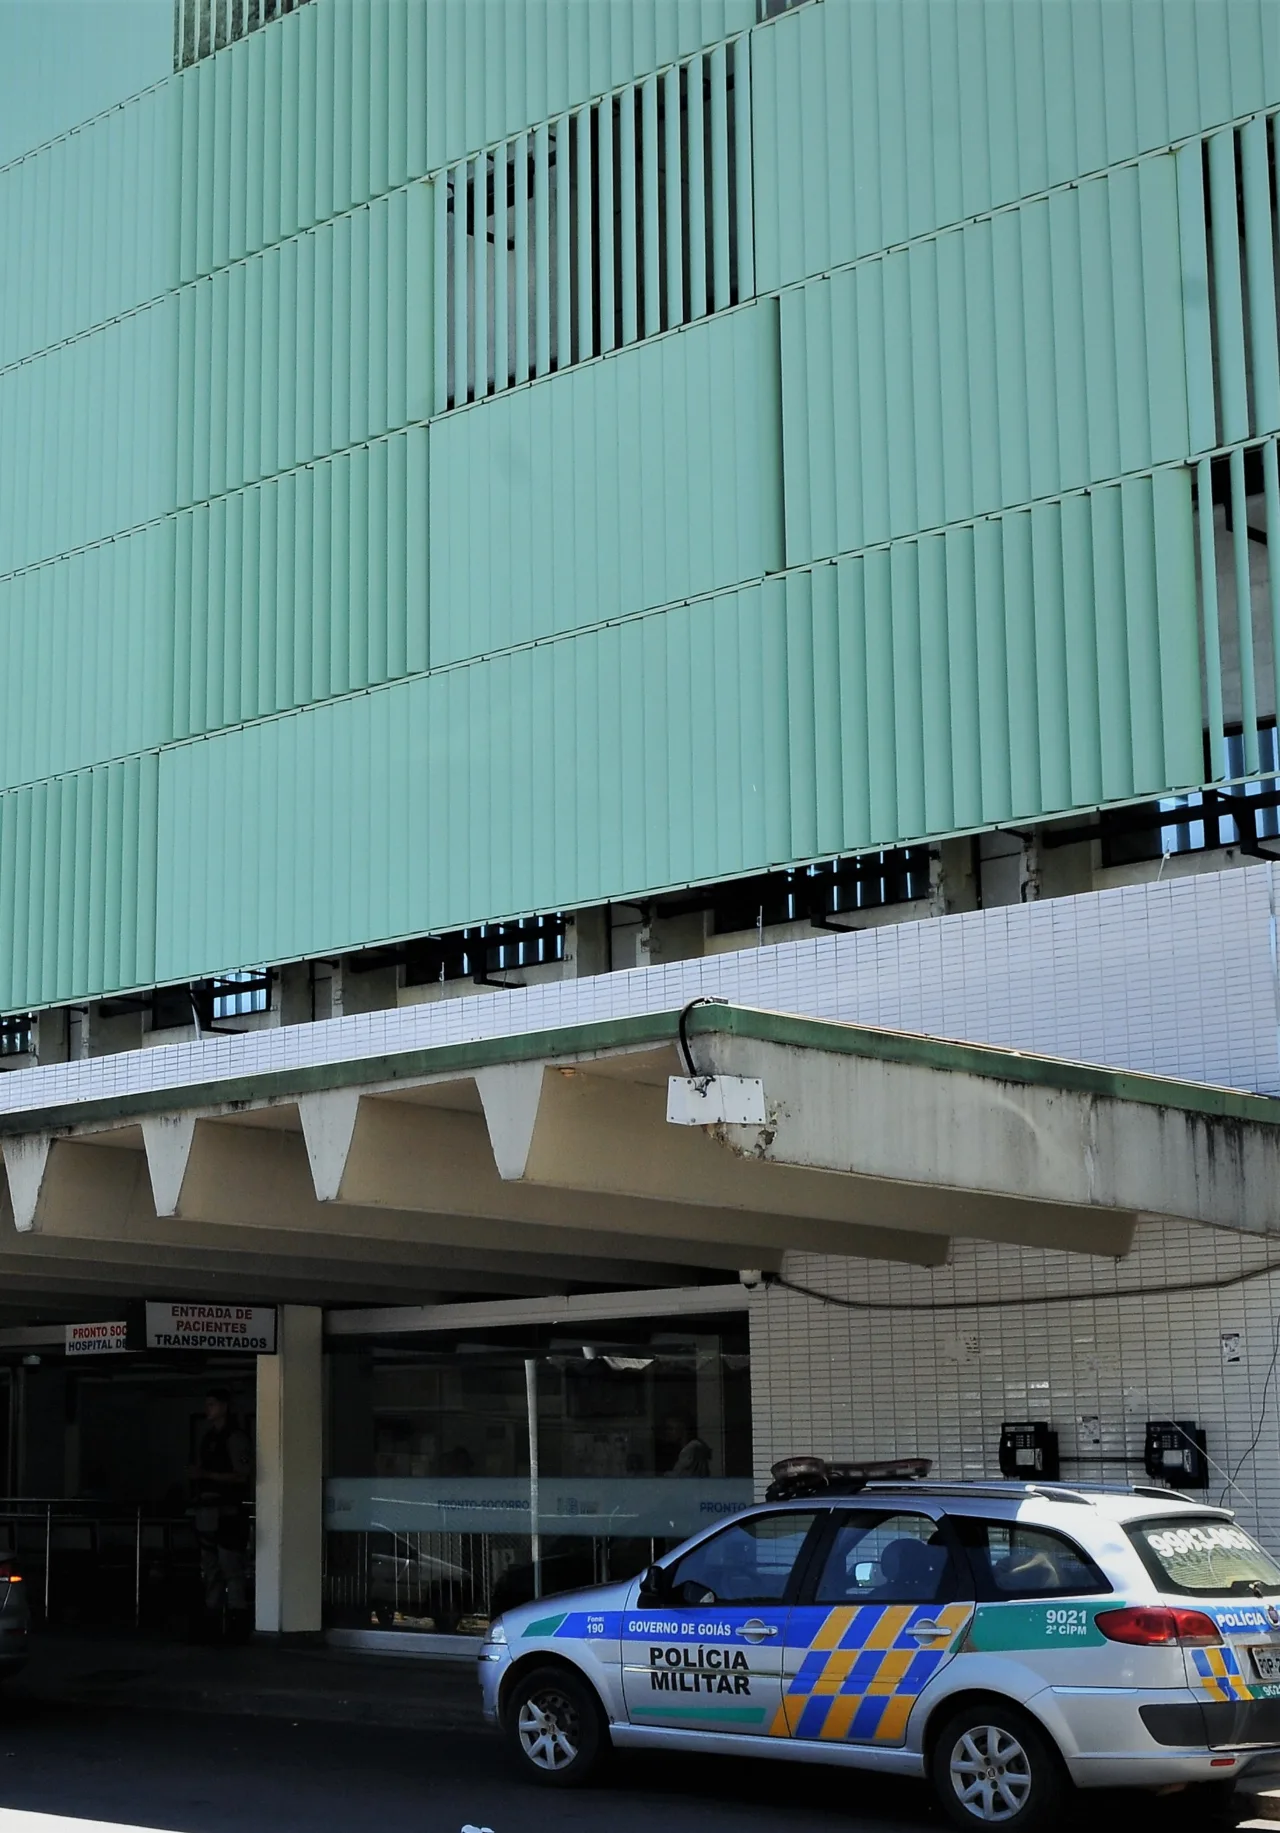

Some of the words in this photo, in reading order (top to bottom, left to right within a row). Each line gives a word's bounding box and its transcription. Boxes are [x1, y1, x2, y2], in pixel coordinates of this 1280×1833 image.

[172, 1306, 232, 1320] ENTRADA
[235, 1309, 253, 1320] DE
[72, 1325, 108, 1338] PRONTO
[176, 1320, 248, 1334] PACIENTES
[69, 1338, 114, 1352] HOSPITAL
[155, 1334, 268, 1349] TRANSPORTADOS
[1046, 1609, 1087, 1624] 9021
[1216, 1610, 1266, 1628] POLÍCIA
[587, 1623, 604, 1634] 190
[628, 1620, 678, 1634] GOVERNO
[681, 1624, 695, 1635] DE
[698, 1621, 731, 1636] GOIÁS
[649, 1644, 750, 1670] POLÍCIA
[650, 1671, 752, 1695] MILITAR
